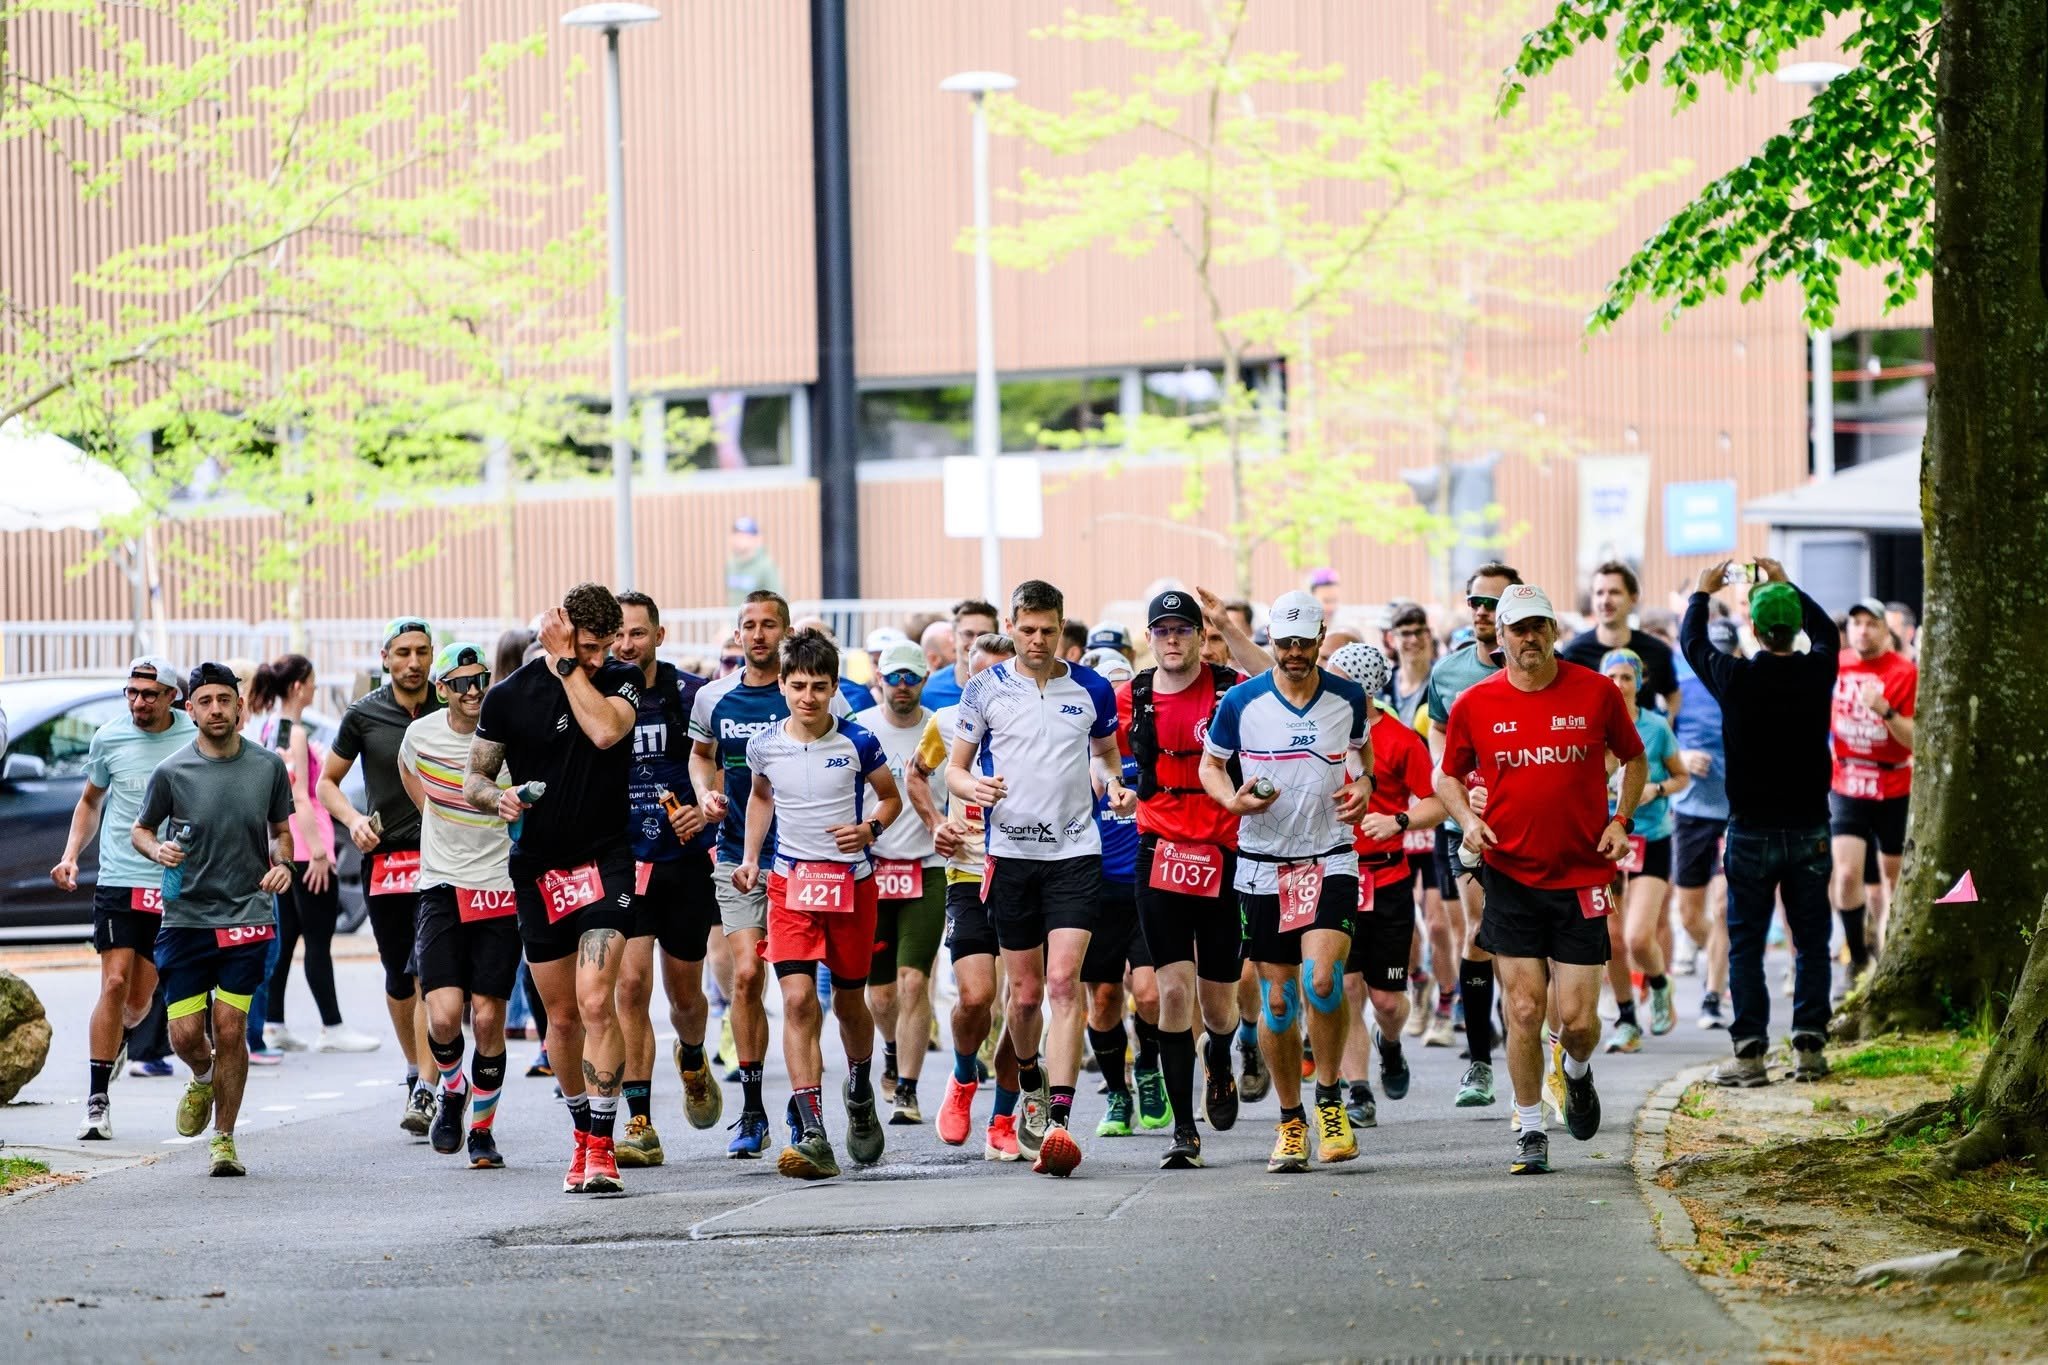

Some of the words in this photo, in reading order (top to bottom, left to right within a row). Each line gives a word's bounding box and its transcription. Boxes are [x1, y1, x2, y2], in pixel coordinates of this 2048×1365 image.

[1060, 704, 1084, 716] DBS
[1493, 721, 1518, 734] OLI
[1289, 734, 1317, 747] DBS
[824, 756, 851, 769] DBS
[1494, 744, 1588, 771] FUNRUN
[875, 874, 913, 895] 509
[1160, 860, 1217, 888] 1037
[470, 889, 514, 912] 402
[552, 881, 594, 913] 554
[798, 884, 841, 907] 421
[1297, 872, 1318, 915] 565
[1388, 967, 1404, 979] NYC
